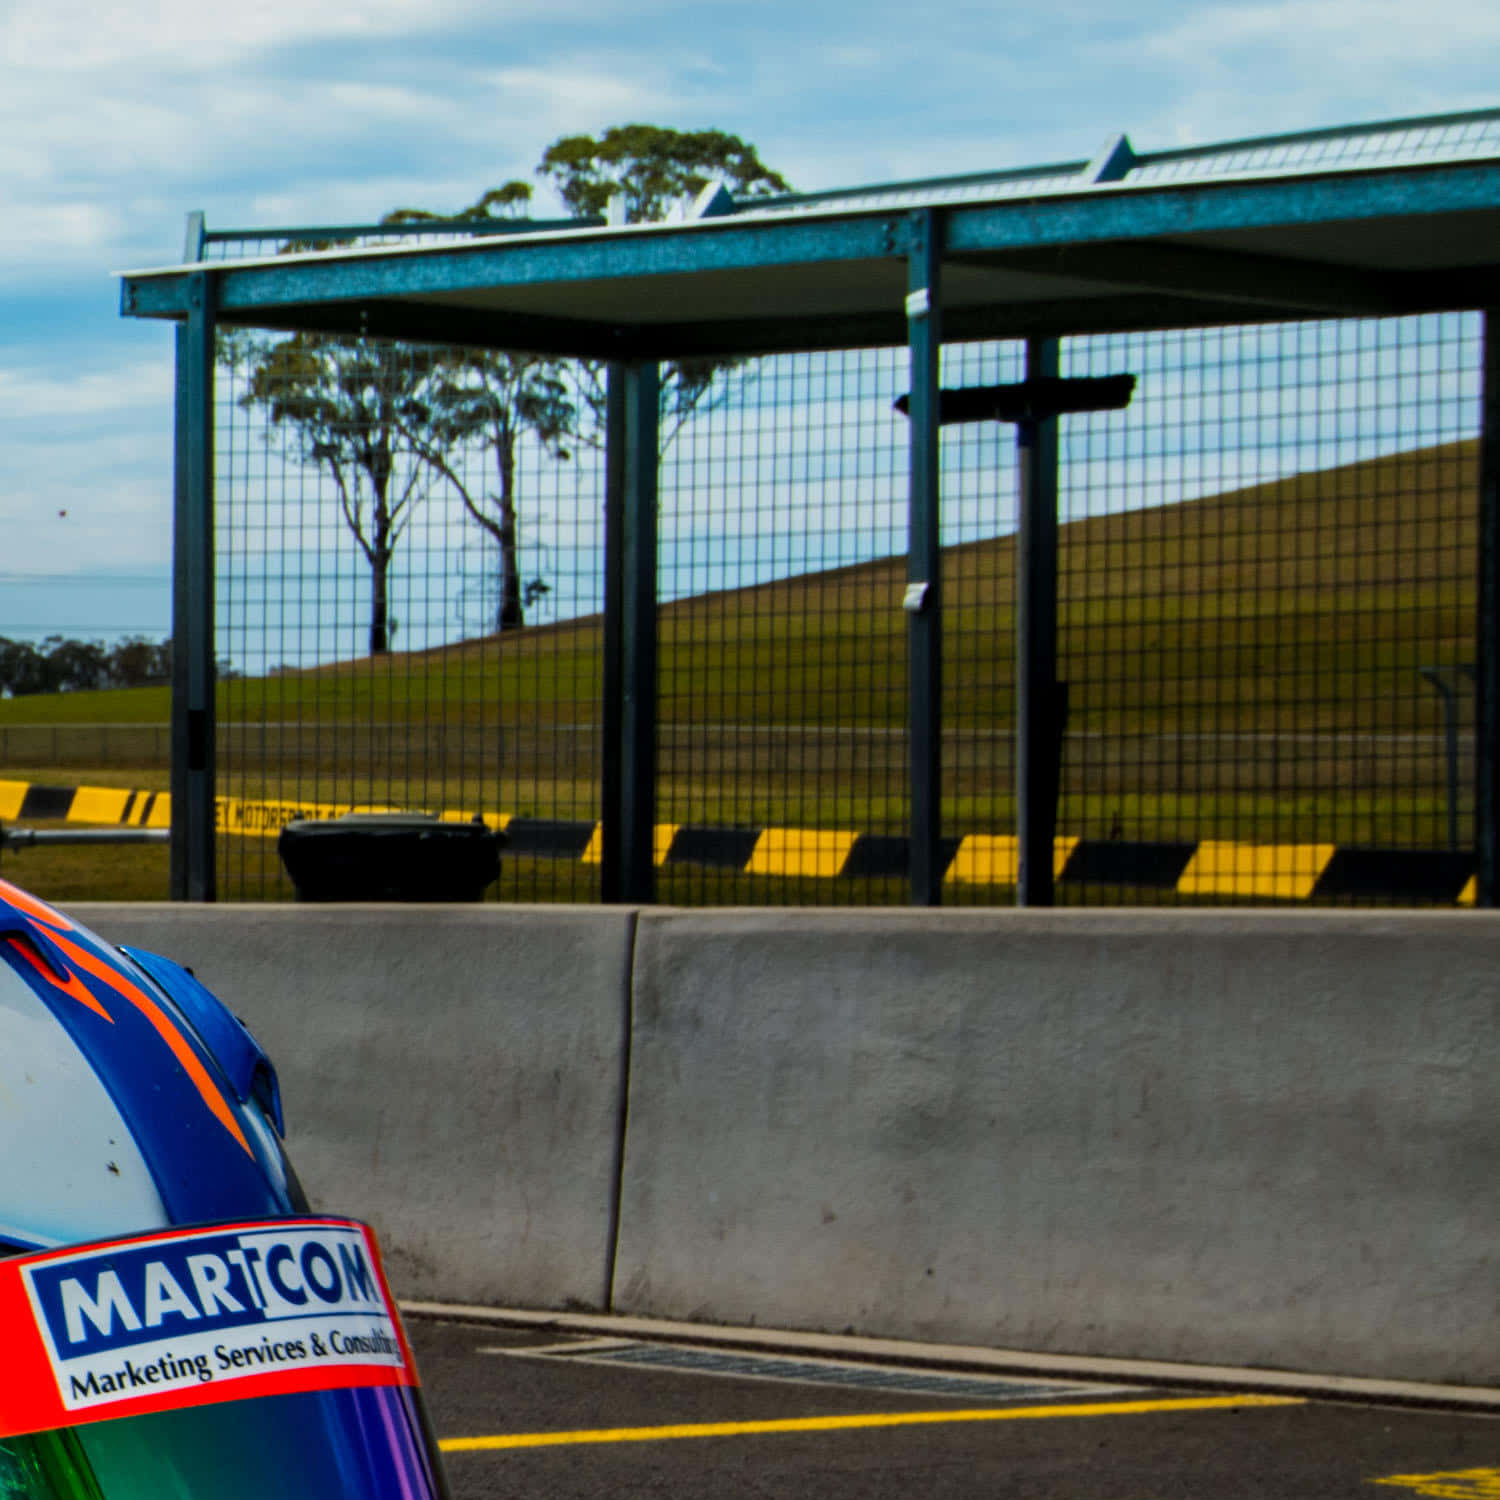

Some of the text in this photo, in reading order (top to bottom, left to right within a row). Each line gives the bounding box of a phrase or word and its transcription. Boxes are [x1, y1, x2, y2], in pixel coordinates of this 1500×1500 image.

[59, 1241, 380, 1344] MARTCOM
[69, 1350, 212, 1400] Marketing
[214, 1336, 306, 1370] Services
[309, 1332, 328, 1358] &
